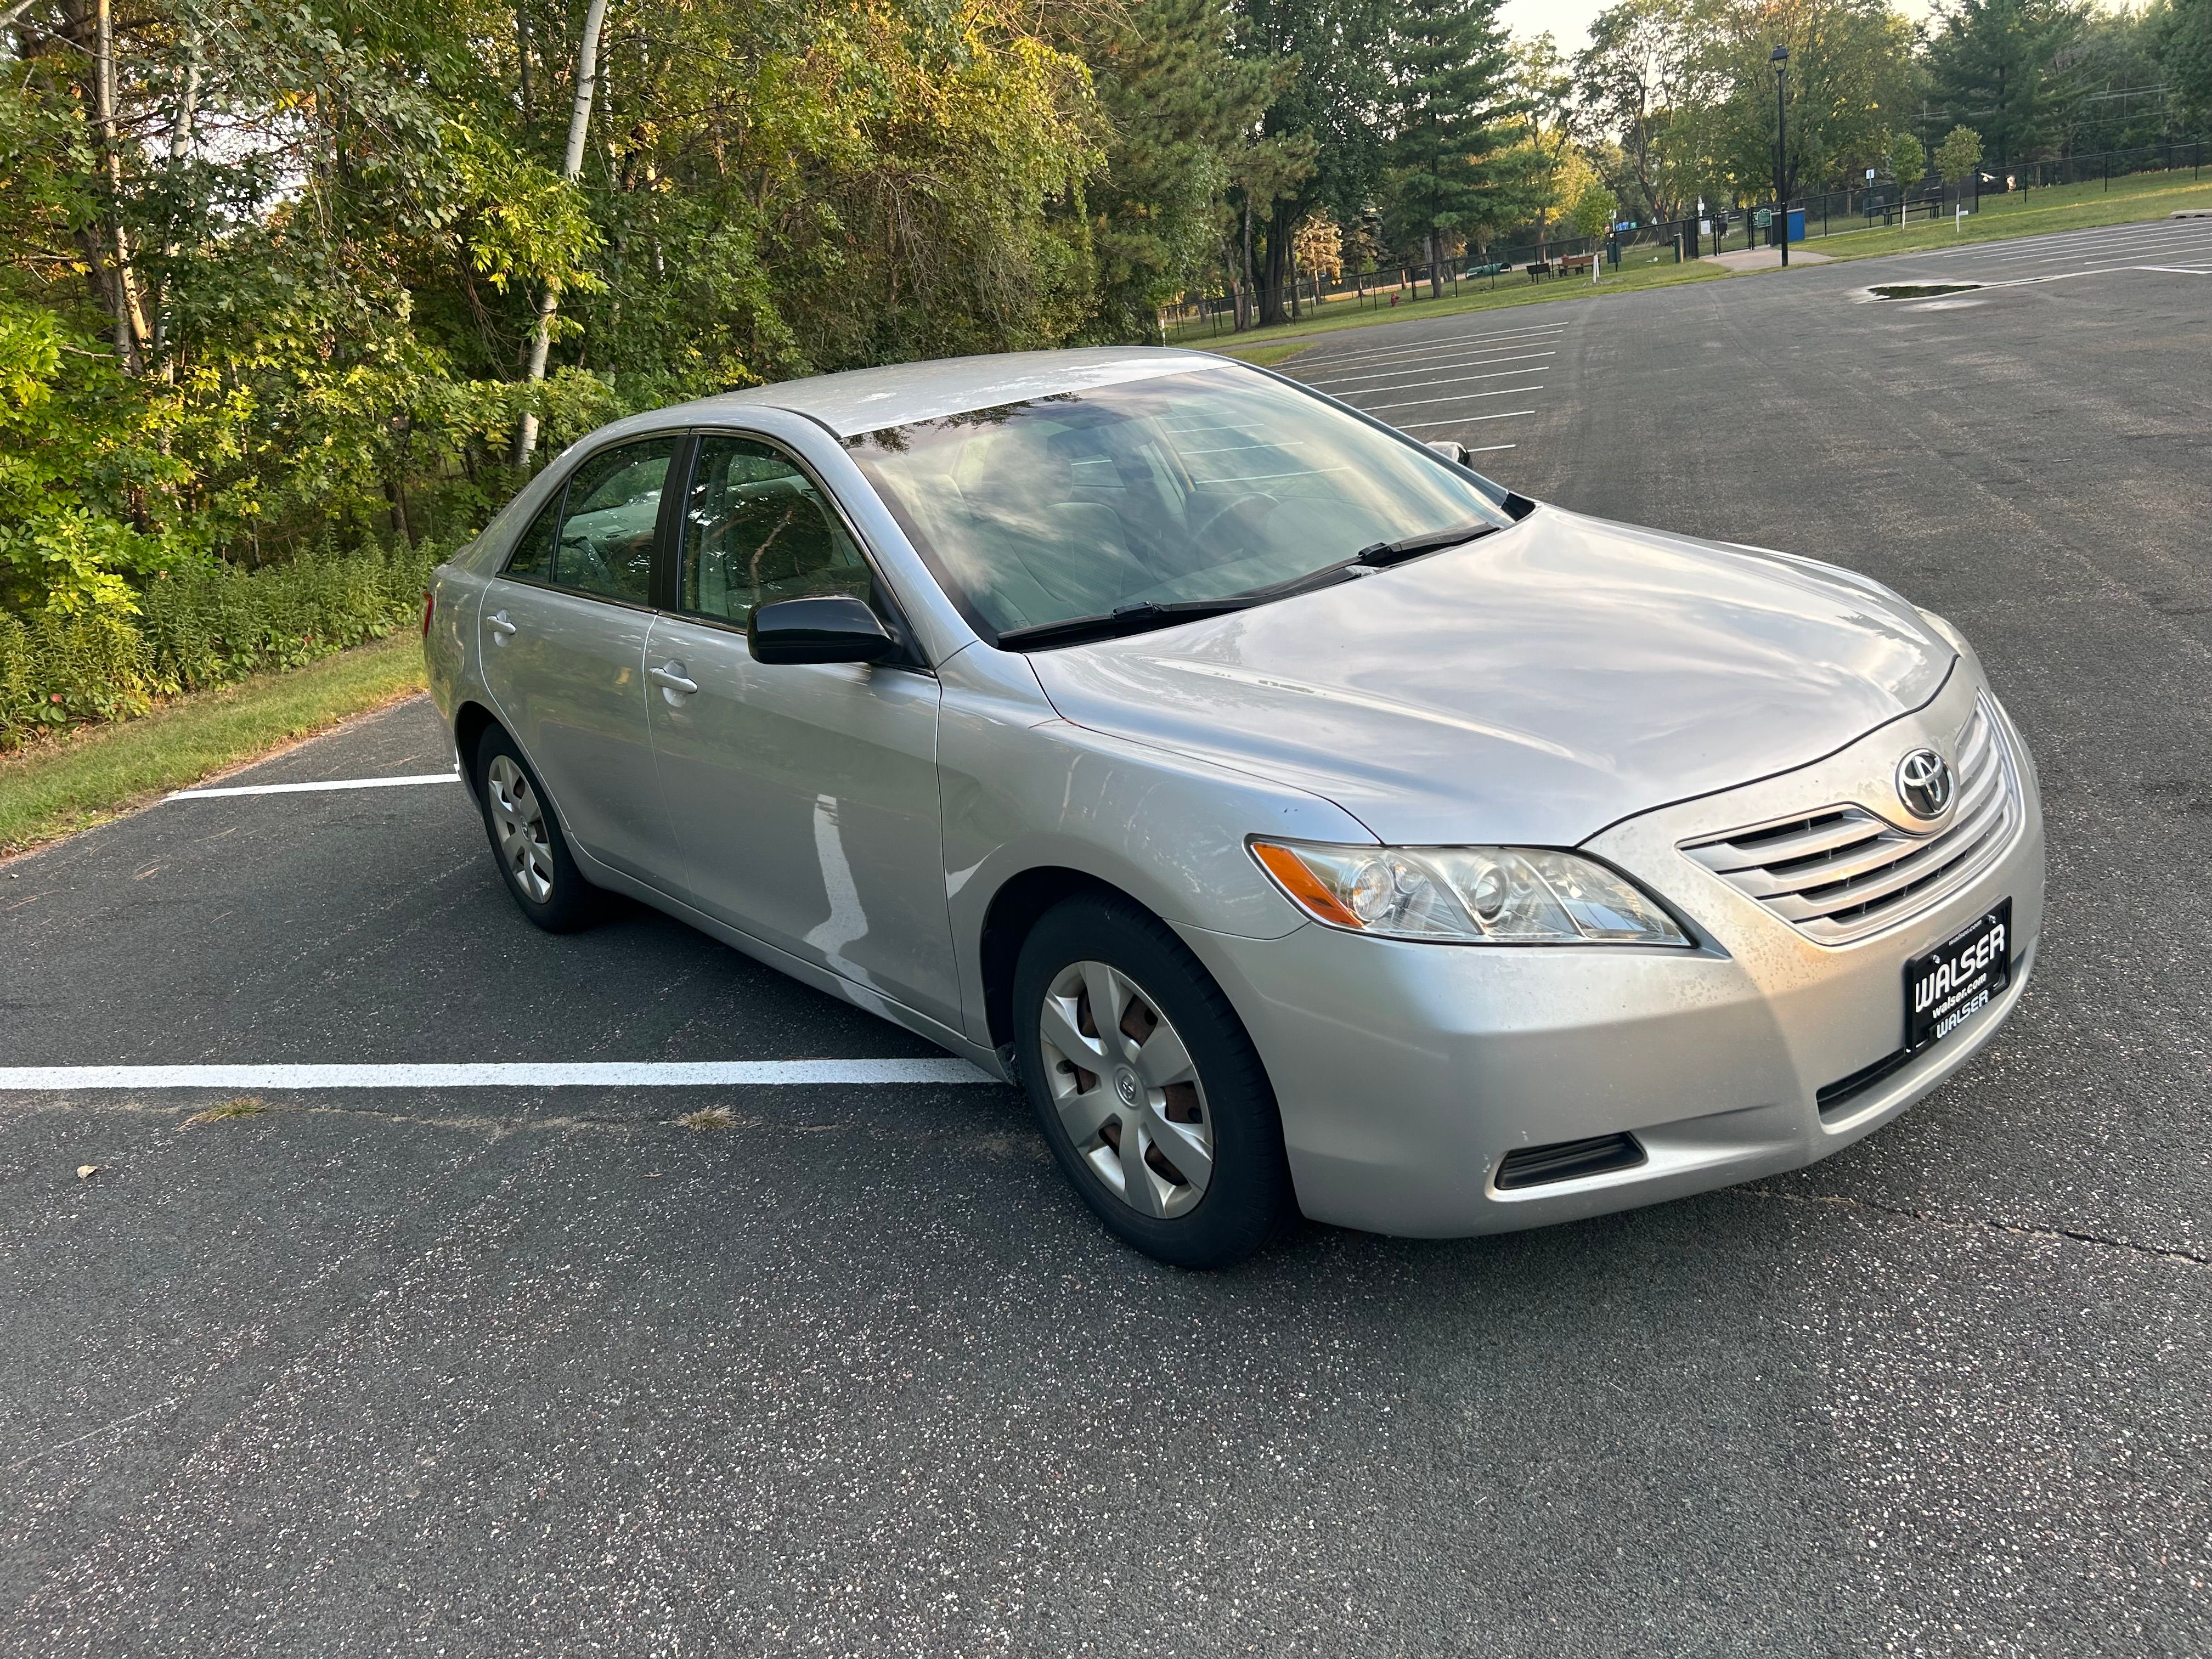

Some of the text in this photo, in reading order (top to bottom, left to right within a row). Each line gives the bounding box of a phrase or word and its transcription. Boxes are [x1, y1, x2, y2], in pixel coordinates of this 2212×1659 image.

[1915, 923, 2005, 1013] WALSER
[1932, 973, 1987, 1019] walser.com
[1937, 989, 1989, 1039] WALSER
